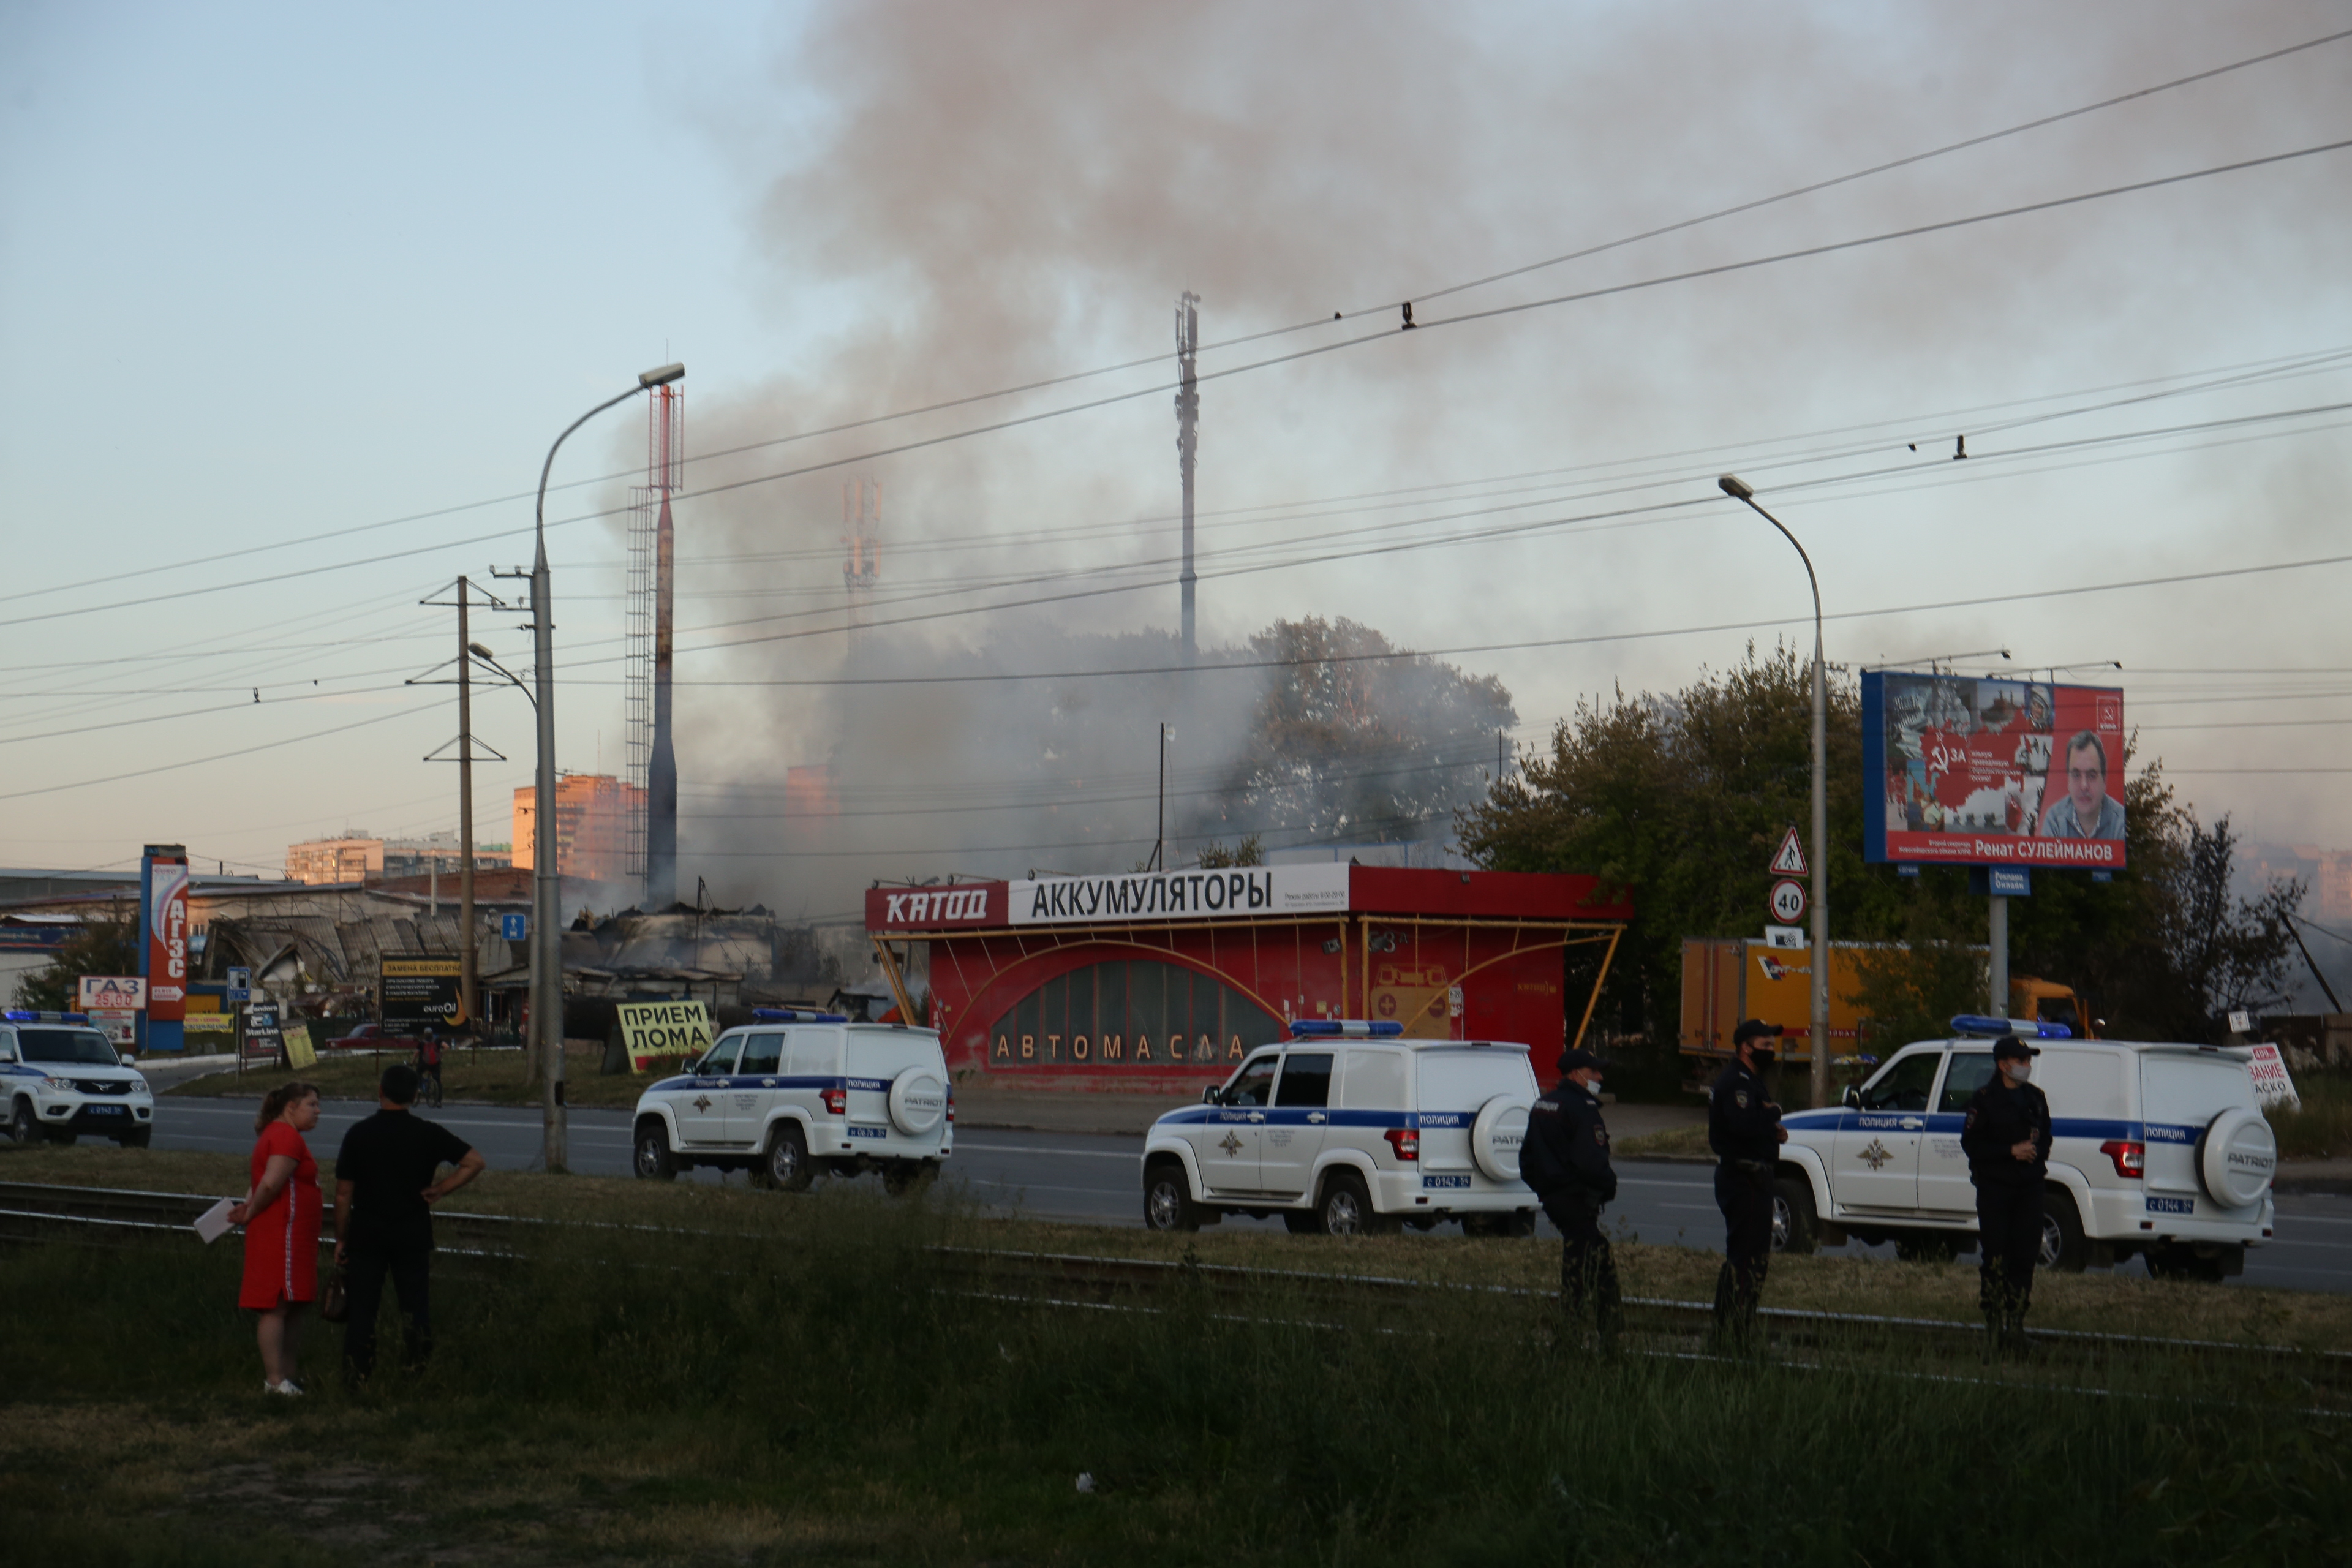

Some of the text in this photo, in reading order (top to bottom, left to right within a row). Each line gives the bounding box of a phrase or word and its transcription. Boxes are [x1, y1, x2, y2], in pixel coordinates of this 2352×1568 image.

[1950, 748, 1967, 763] ЗА
[1975, 839, 2113, 861] Ренат СУЛЕЙМАНОВ
[1994, 870, 2023, 881] Реклама
[1995, 880, 2024, 890] Онлайн
[1031, 872, 1272, 918] АККУМУЛЯТОРЫ
[1779, 893, 1799, 911] 40
[886, 889, 987, 923] КАТОД
[168, 899, 186, 979] АГЗС
[86, 979, 139, 994] ГАЗ
[94, 994, 132, 1006] 25.00
[423, 1002, 456, 1013] euroOil
[623, 1005, 702, 1025] ПРИЕМ
[245, 1028, 279, 1036] StarLine
[632, 1027, 708, 1048] ЛОМА
[996, 1034, 1244, 1060] АВТОМАСЛА
[848, 1079, 880, 1089] ПОЛИЦИЯ
[905, 1096, 943, 1107] PATRIOT
[1420, 1115, 1460, 1126] ПОЛИЦИЯ
[1858, 1116, 1898, 1128] ПОЛИЦИЯ
[1492, 1135, 1525, 1145] PATR
[2146, 1126, 2185, 1140] ПОЛИЦИЯ
[2228, 1152, 2274, 1169] PATRIOT
[2158, 1199, 2179, 1212] 0144
